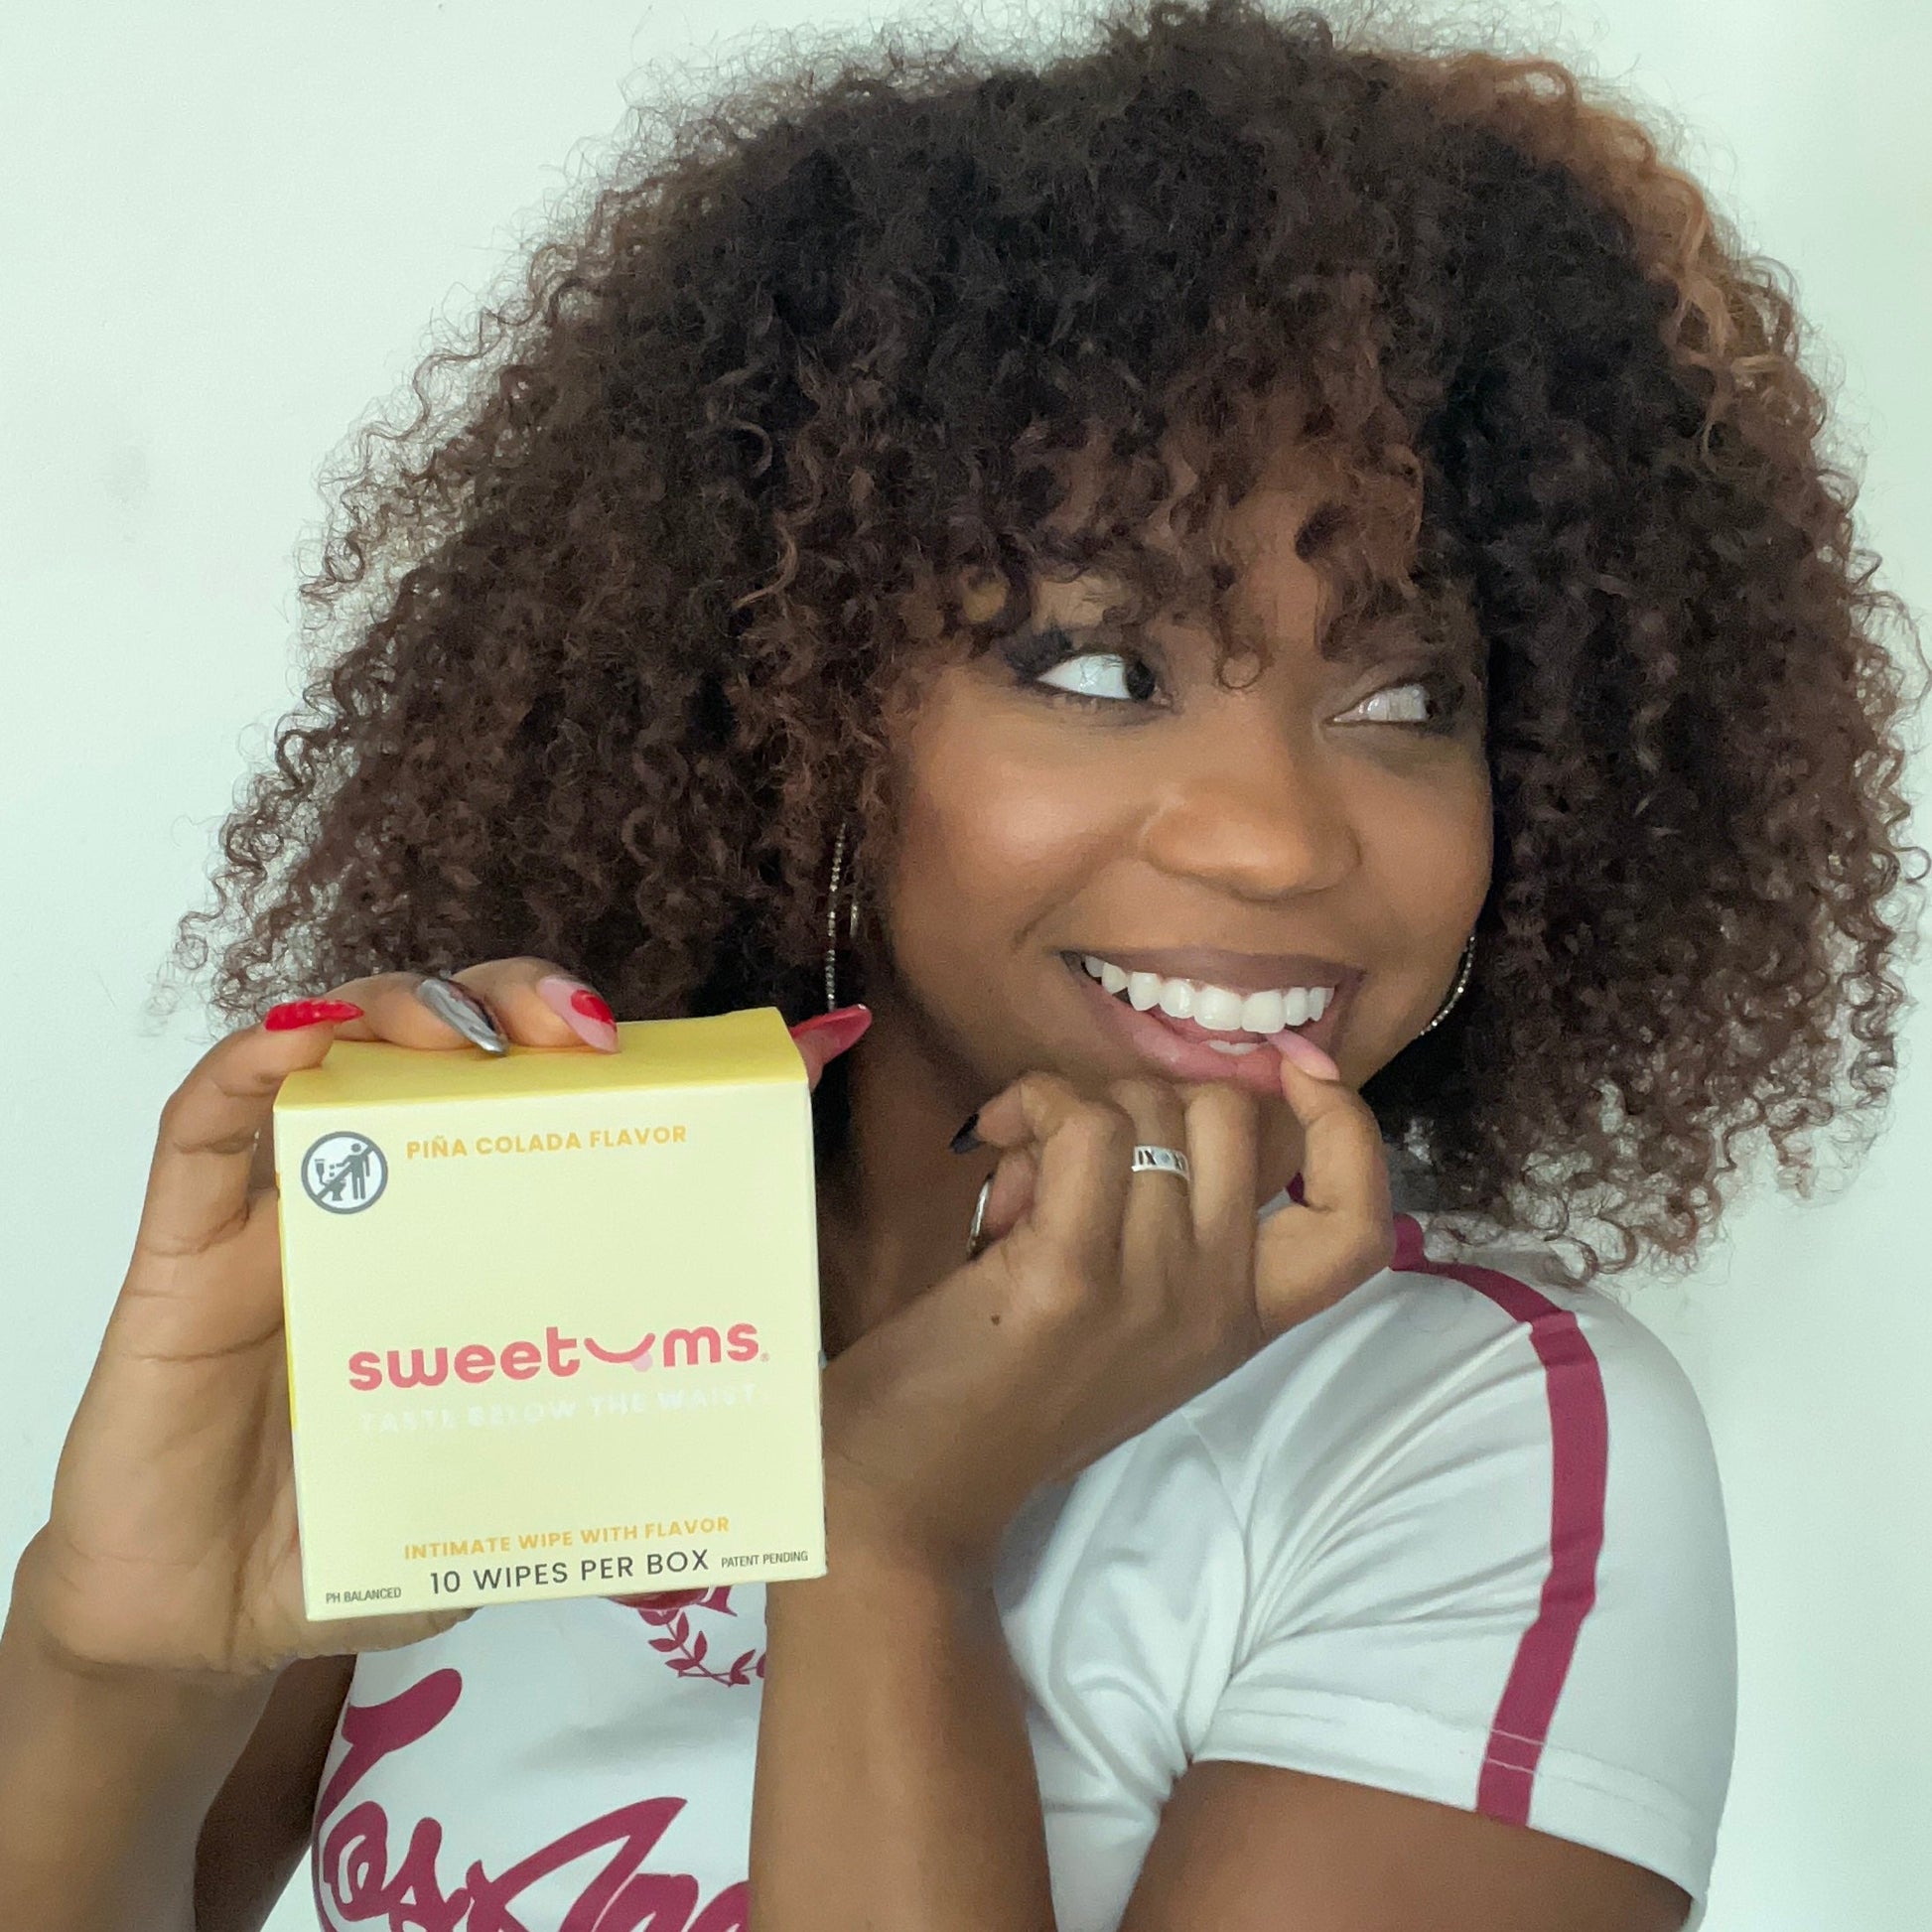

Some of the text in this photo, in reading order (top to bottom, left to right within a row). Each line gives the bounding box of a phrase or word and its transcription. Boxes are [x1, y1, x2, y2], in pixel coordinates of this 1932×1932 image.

[406, 1125, 687, 1160] PIÑA COLADA FLAVOR
[467, 1401, 577, 1428] BELOW
[590, 1392, 647, 1419] THE
[657, 1383, 757, 1410] WAIST
[404, 1516, 730, 1560] INTIMATE WIPE WITH FLAVOR
[430, 1549, 709, 1594] 10 WIPES PER BOX
[721, 1551, 809, 1569] PATENT PENDING
[326, 1587, 402, 1604] PH BALANCED
